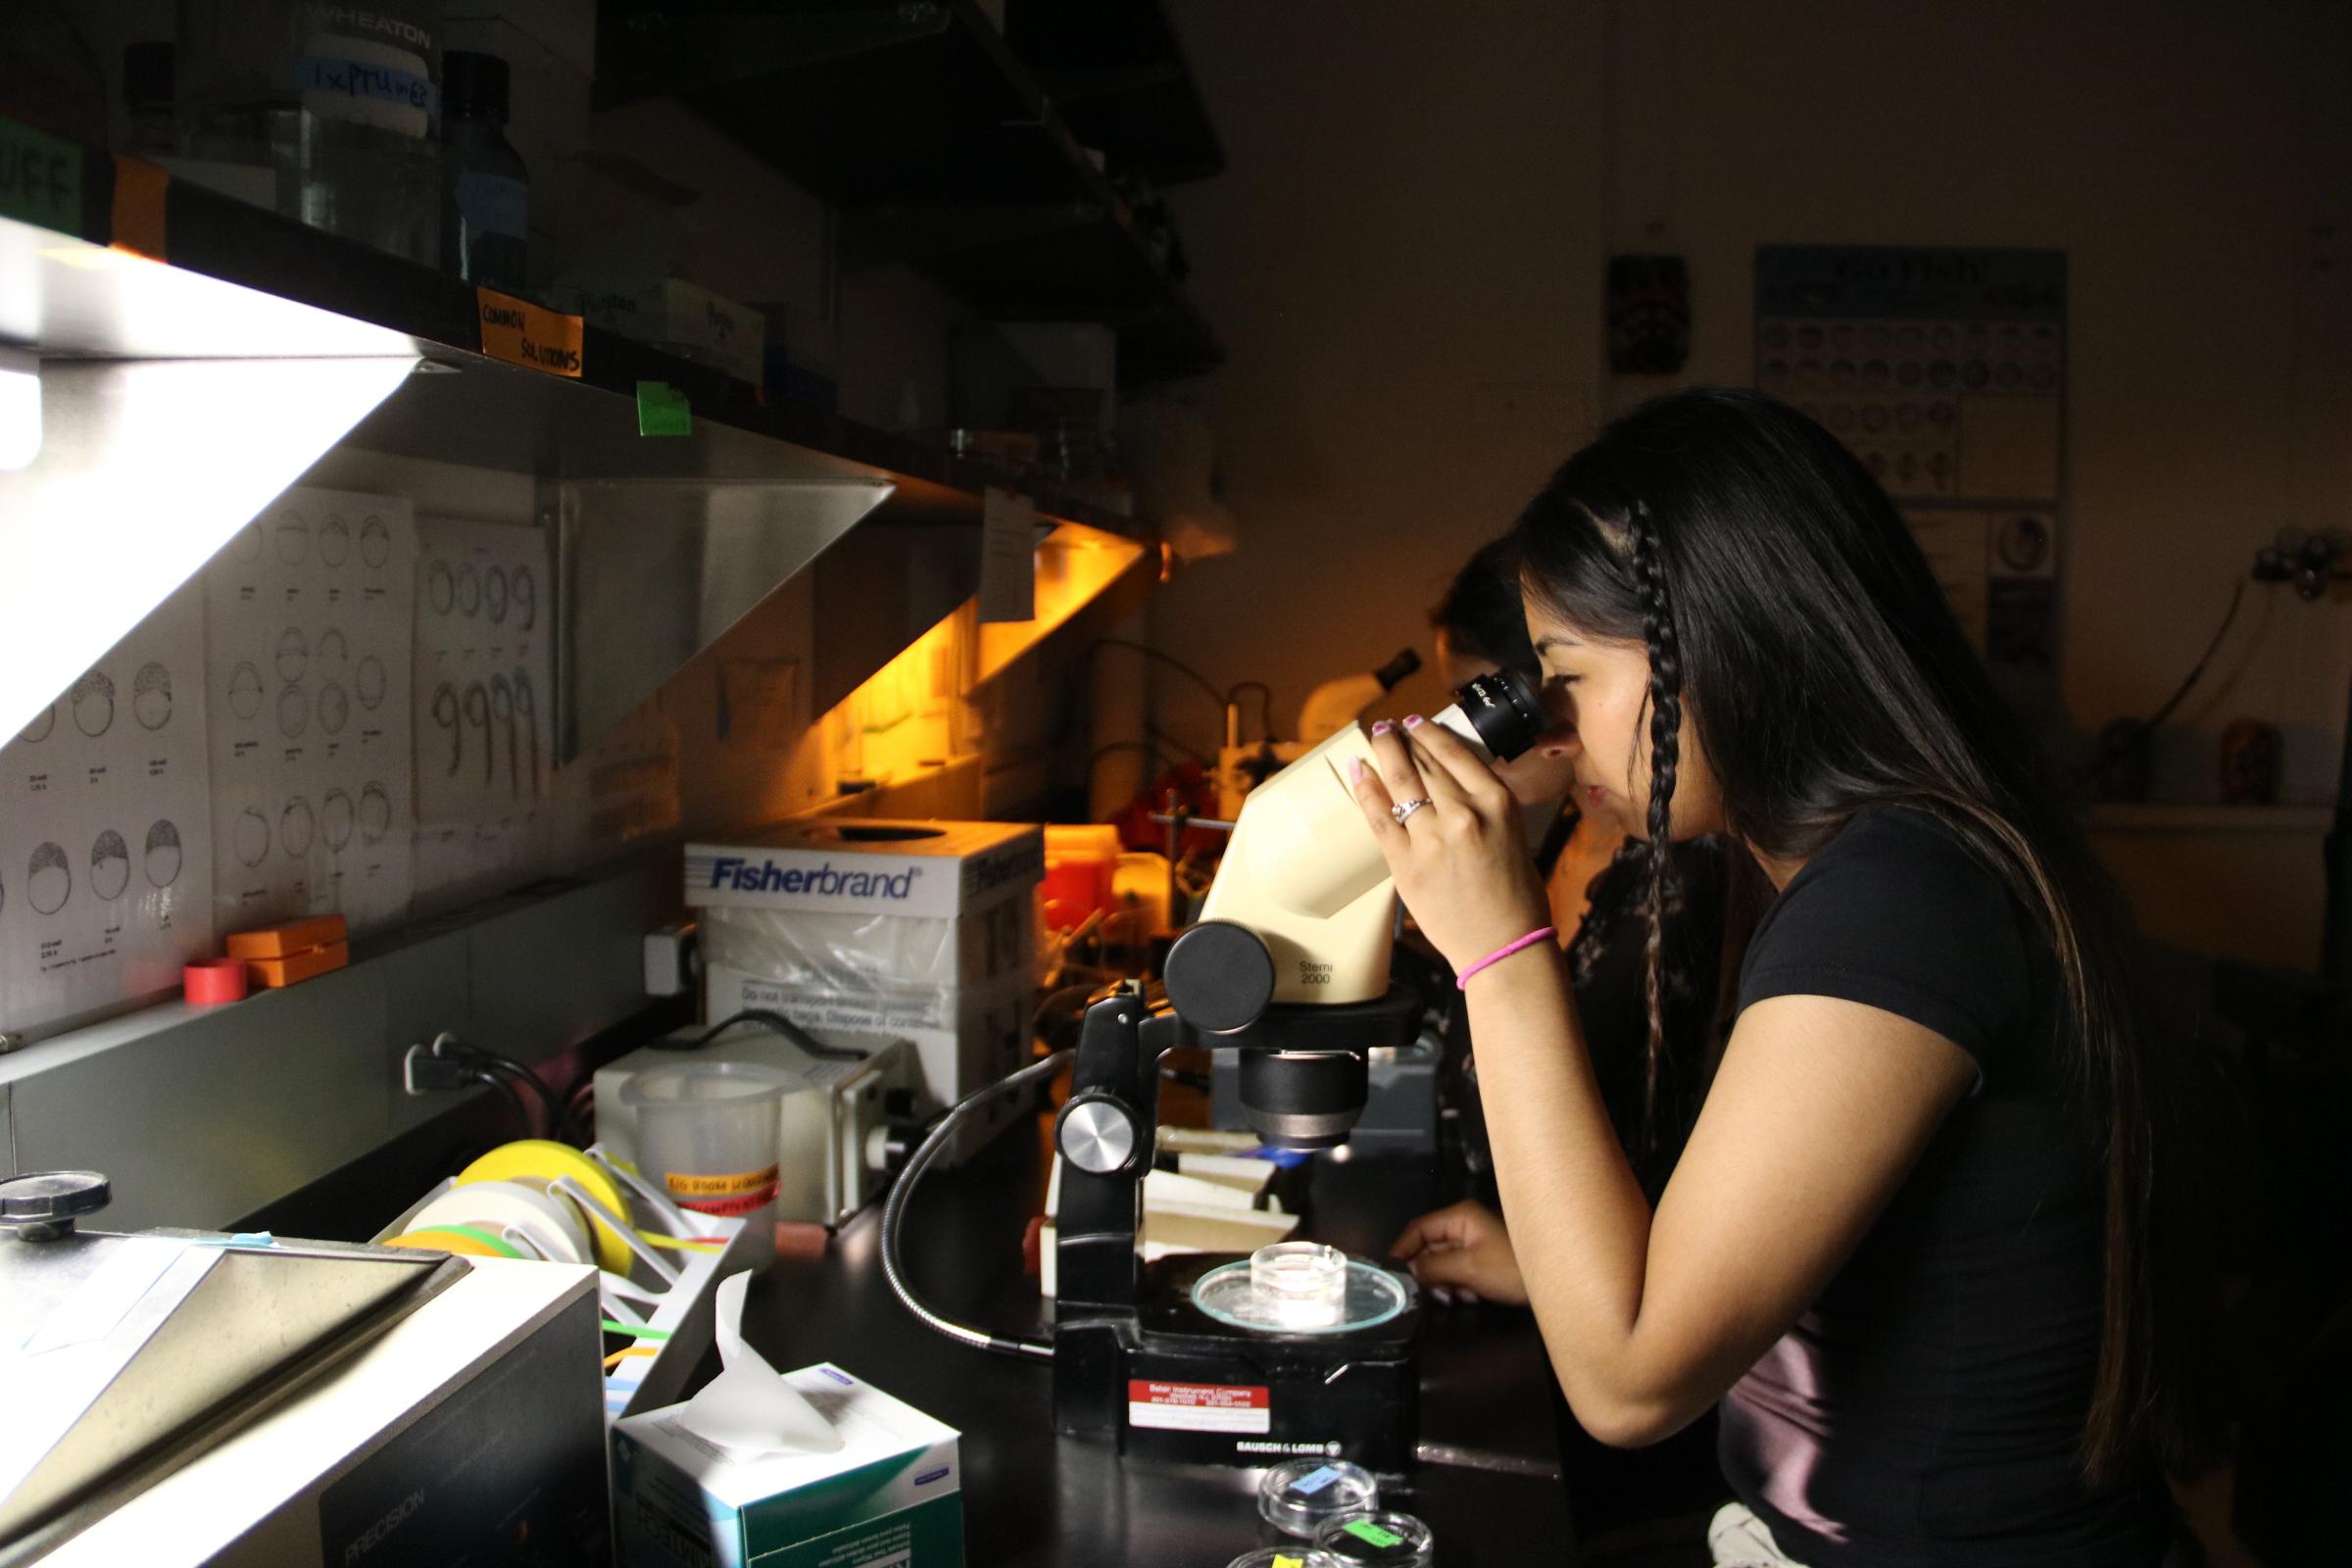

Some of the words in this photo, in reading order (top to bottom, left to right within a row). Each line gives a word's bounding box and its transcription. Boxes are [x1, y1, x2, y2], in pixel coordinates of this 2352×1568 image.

[306, 3, 431, 49] WHEATON
[482, 303, 525, 332] COMMON
[521, 337, 580, 372] SOLUTIONS
[709, 857, 915, 900] Fisherbrand
[1299, 960, 1333, 973] Stemi
[1301, 973, 1331, 984] 2000
[1237, 1442, 1282, 1453] BAUSCH
[1292, 1444, 1325, 1455] LOMB
[344, 1488, 425, 1566] PRECISION
